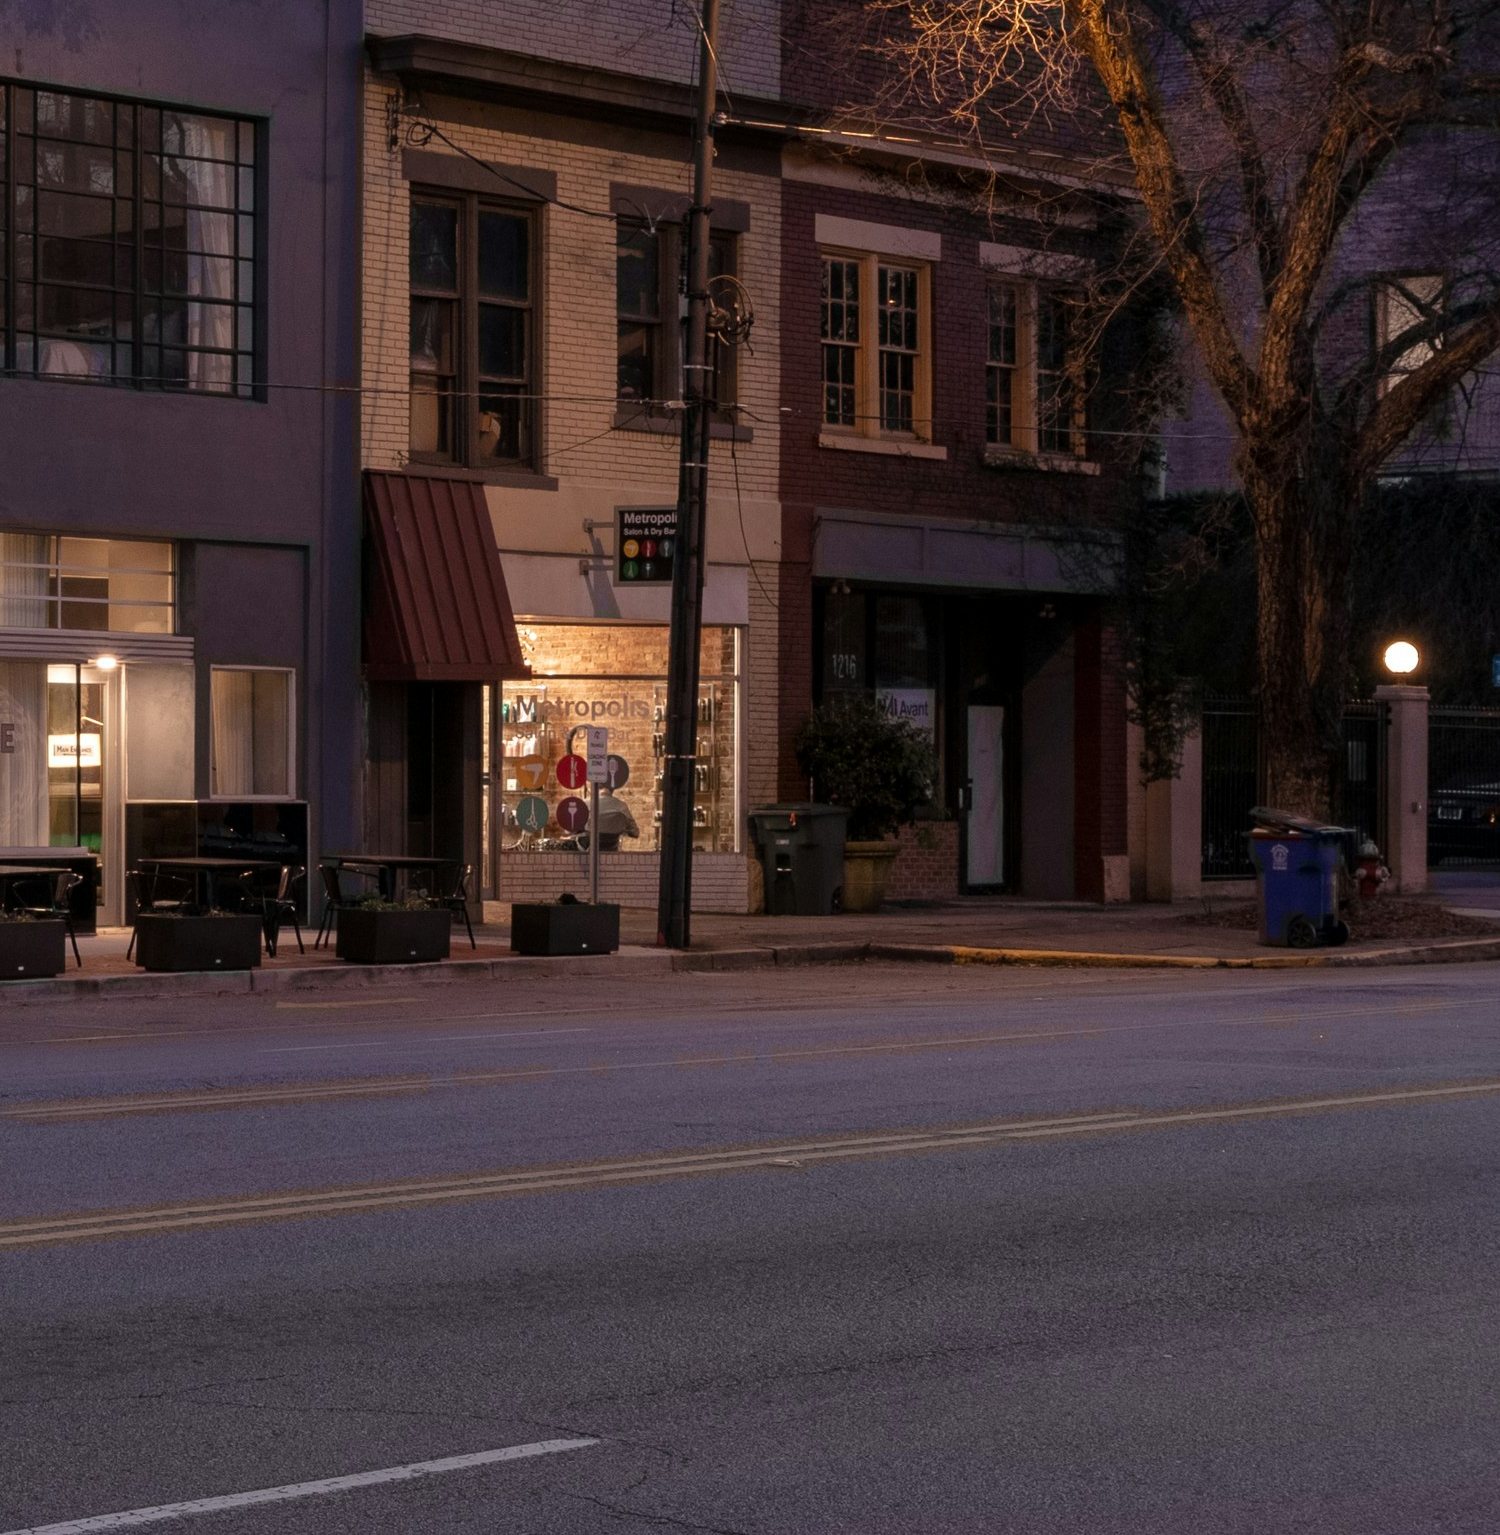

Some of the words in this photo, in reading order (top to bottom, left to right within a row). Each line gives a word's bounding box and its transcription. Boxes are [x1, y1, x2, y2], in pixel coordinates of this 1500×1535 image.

[624, 512, 678, 526] Metropoli
[623, 527, 643, 535] Salon
[644, 527, 650, 535] &
[650, 527, 663, 536] Dry
[663, 527, 676, 535] Bar
[832, 653, 857, 679] 1216
[516, 694, 649, 721] Metropolis
[900, 700, 928, 717] Avant
